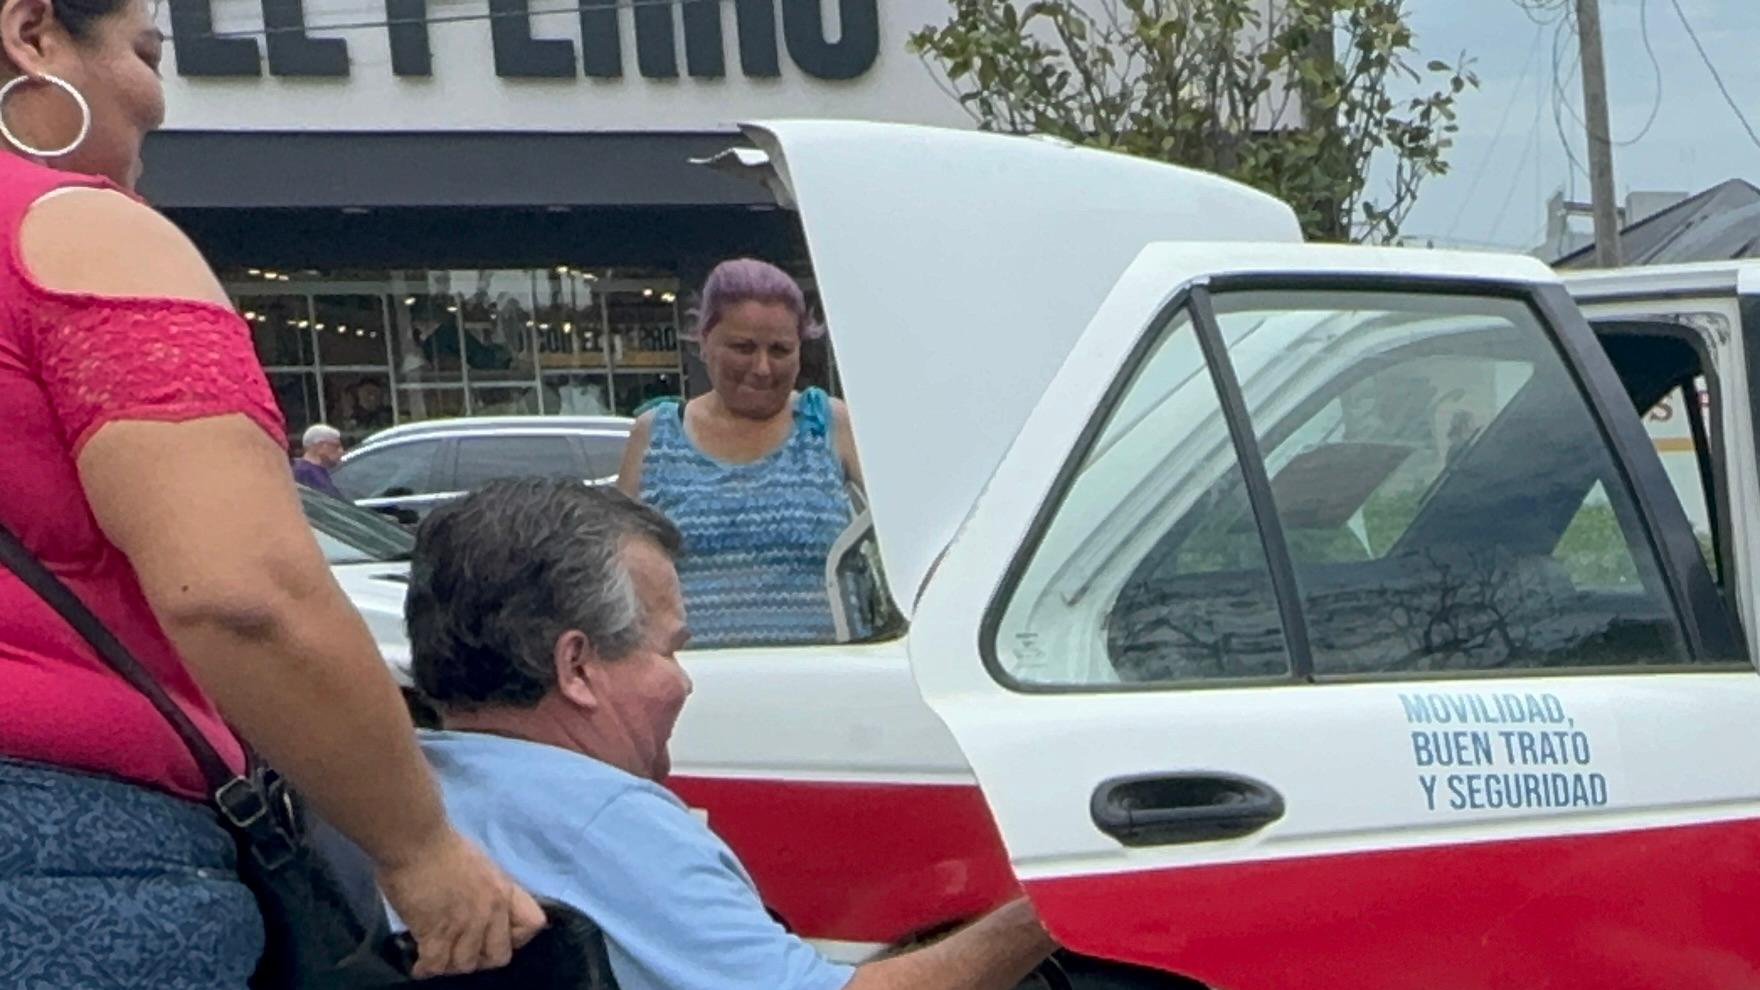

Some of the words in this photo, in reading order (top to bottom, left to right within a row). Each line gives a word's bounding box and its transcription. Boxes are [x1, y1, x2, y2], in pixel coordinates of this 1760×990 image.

[1397, 692, 1575, 730] MOVILIDAD,
[1410, 730, 1494, 767] BUEN
[1499, 730, 1592, 766] TRATO
[1418, 774, 1437, 811] Y
[1446, 772, 1609, 811] SEGURIDAD
